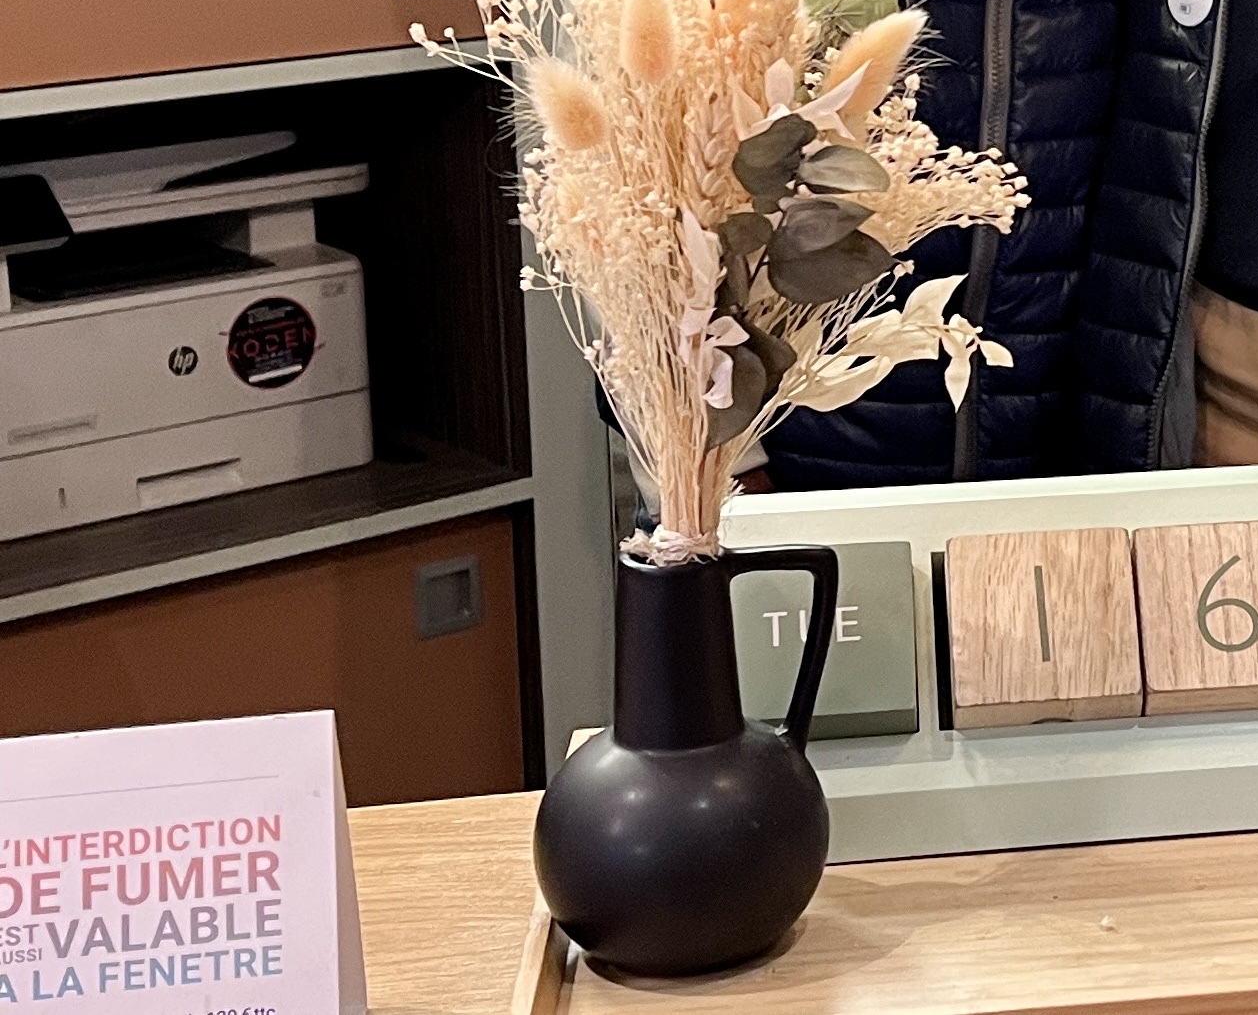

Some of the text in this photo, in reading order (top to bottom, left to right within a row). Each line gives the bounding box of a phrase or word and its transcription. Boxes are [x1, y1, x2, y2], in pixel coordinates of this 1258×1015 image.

[170, 346, 197, 375] hp
[762, 605, 862, 647] TE
[0, 850, 281, 919] DE FUMER
[0, 923, 40, 947] ST
[45, 898, 283, 959] VALABLE
[0, 947, 43, 966] USSI
[32, 966, 85, 1001] LA
[99, 944, 284, 994] FENETRE
